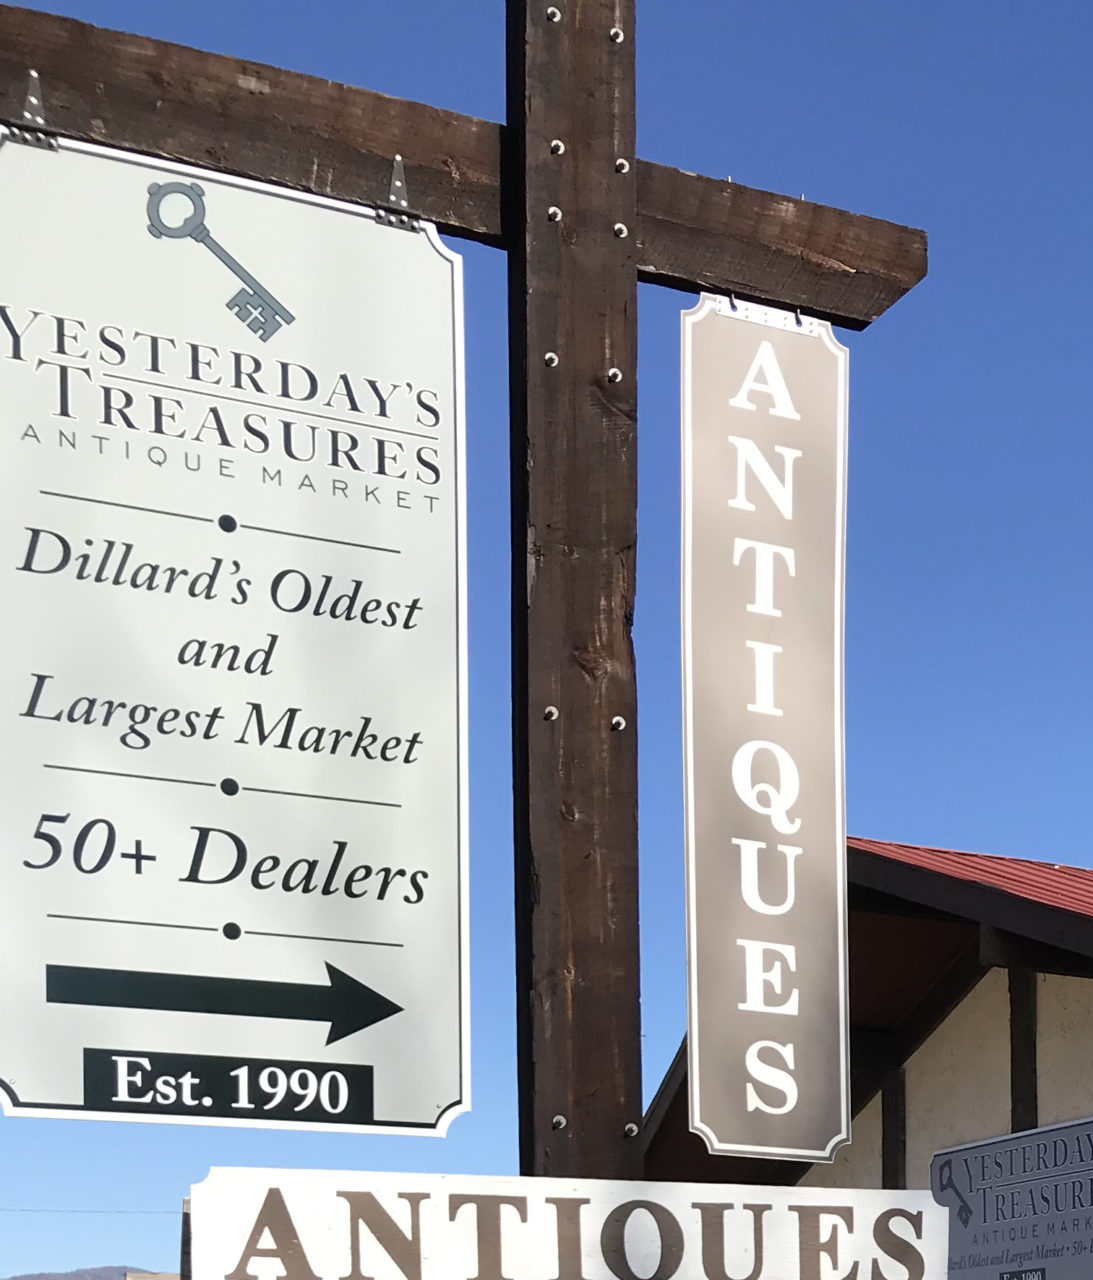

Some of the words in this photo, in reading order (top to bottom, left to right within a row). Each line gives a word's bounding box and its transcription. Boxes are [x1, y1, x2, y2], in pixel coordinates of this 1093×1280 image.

[0, 305, 441, 428] YESTERDAY'S
[36, 359, 442, 485] TREASURES
[21, 424, 235, 478] ANTIQUE
[262, 466, 440, 513] MARKET
[16, 527, 251, 605] Dillard's
[270, 569, 423, 629] Oldest
[177, 633, 279, 676] and
[19, 673, 225, 750] Largest
[234, 702, 423, 764] Market
[727, 340, 803, 1115] ANTIQUES
[23, 813, 156, 875] 50+
[178, 826, 429, 904] Dealers
[111, 1055, 213, 1107] Est.
[229, 1065, 349, 1114] 1990
[968, 1253, 989, 1269] Oldest
[1005, 1248, 1033, 1268] Largest
[1036, 1243, 1064, 1260] Market
[1071, 1240, 1087, 1256] 50+
[972, 1224, 1039, 1246] ANTIQUE
